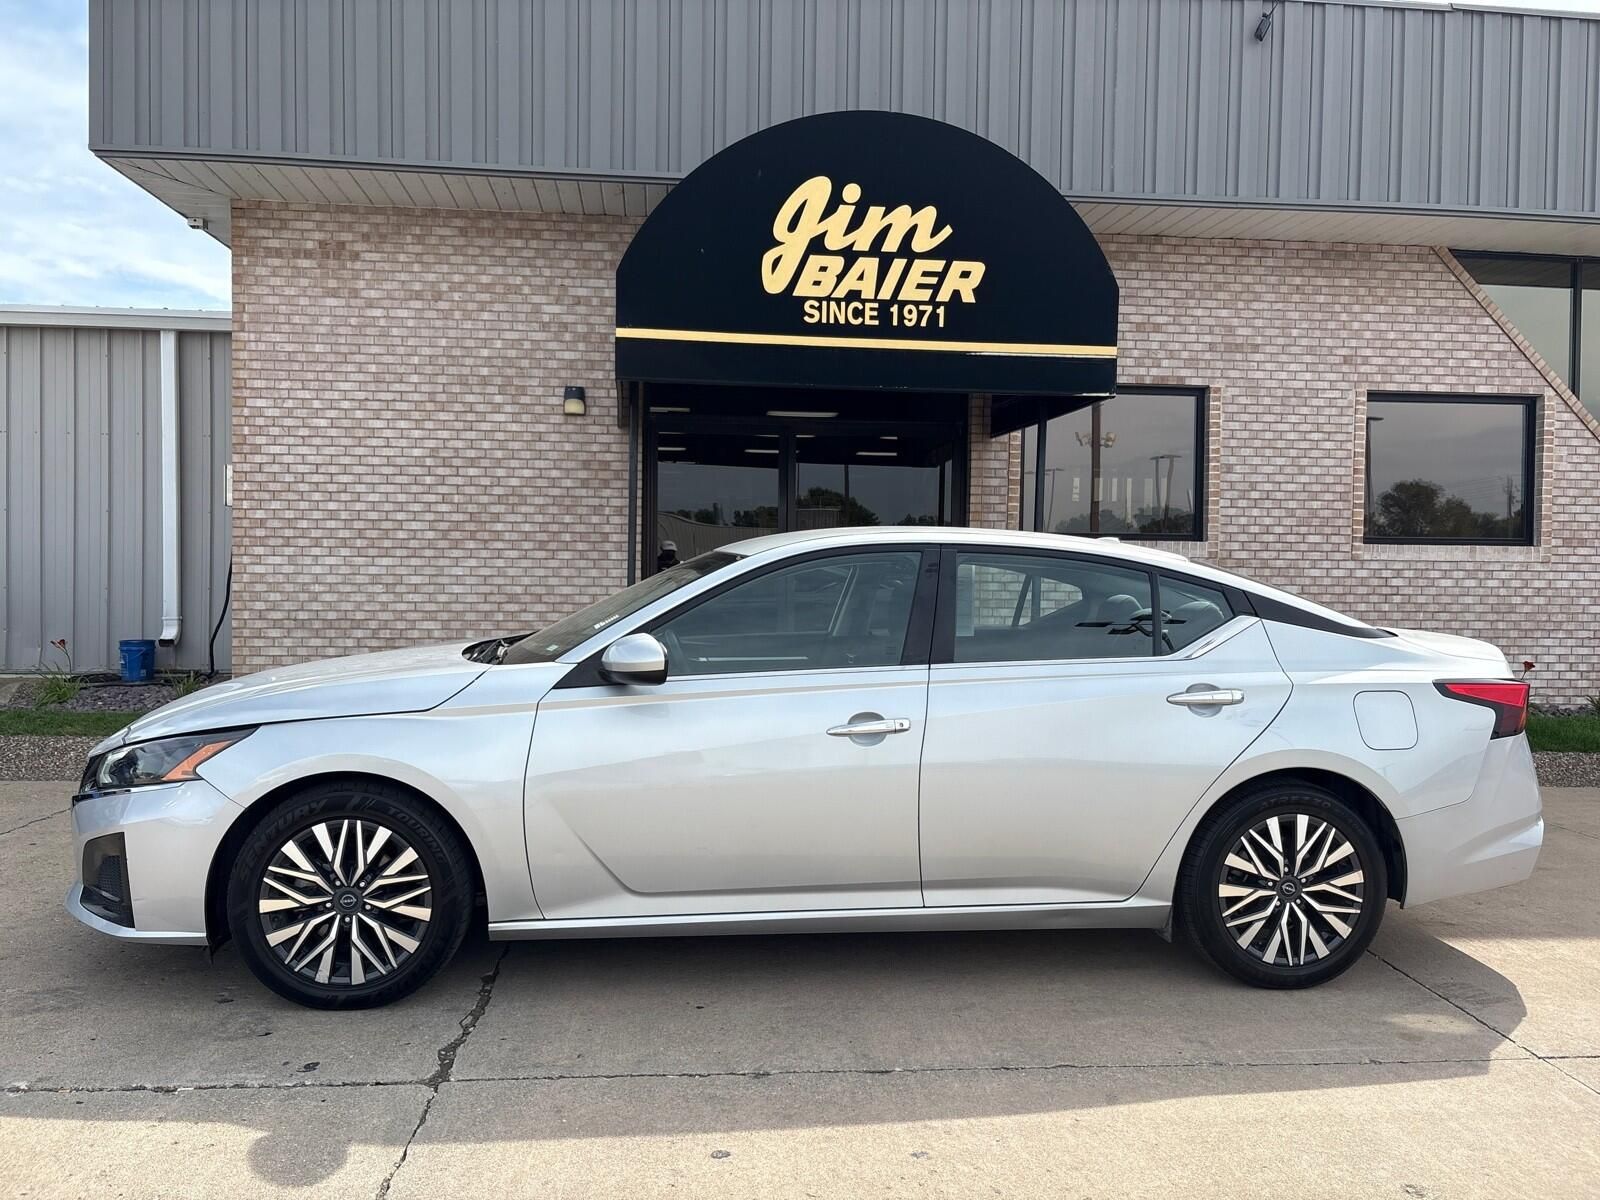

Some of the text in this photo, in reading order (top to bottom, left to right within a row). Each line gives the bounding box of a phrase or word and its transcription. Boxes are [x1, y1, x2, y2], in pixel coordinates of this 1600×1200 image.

[761, 175, 953, 295] Jim
[792, 255, 986, 304] BAIER
[803, 300, 945, 328] SINCE 1971
